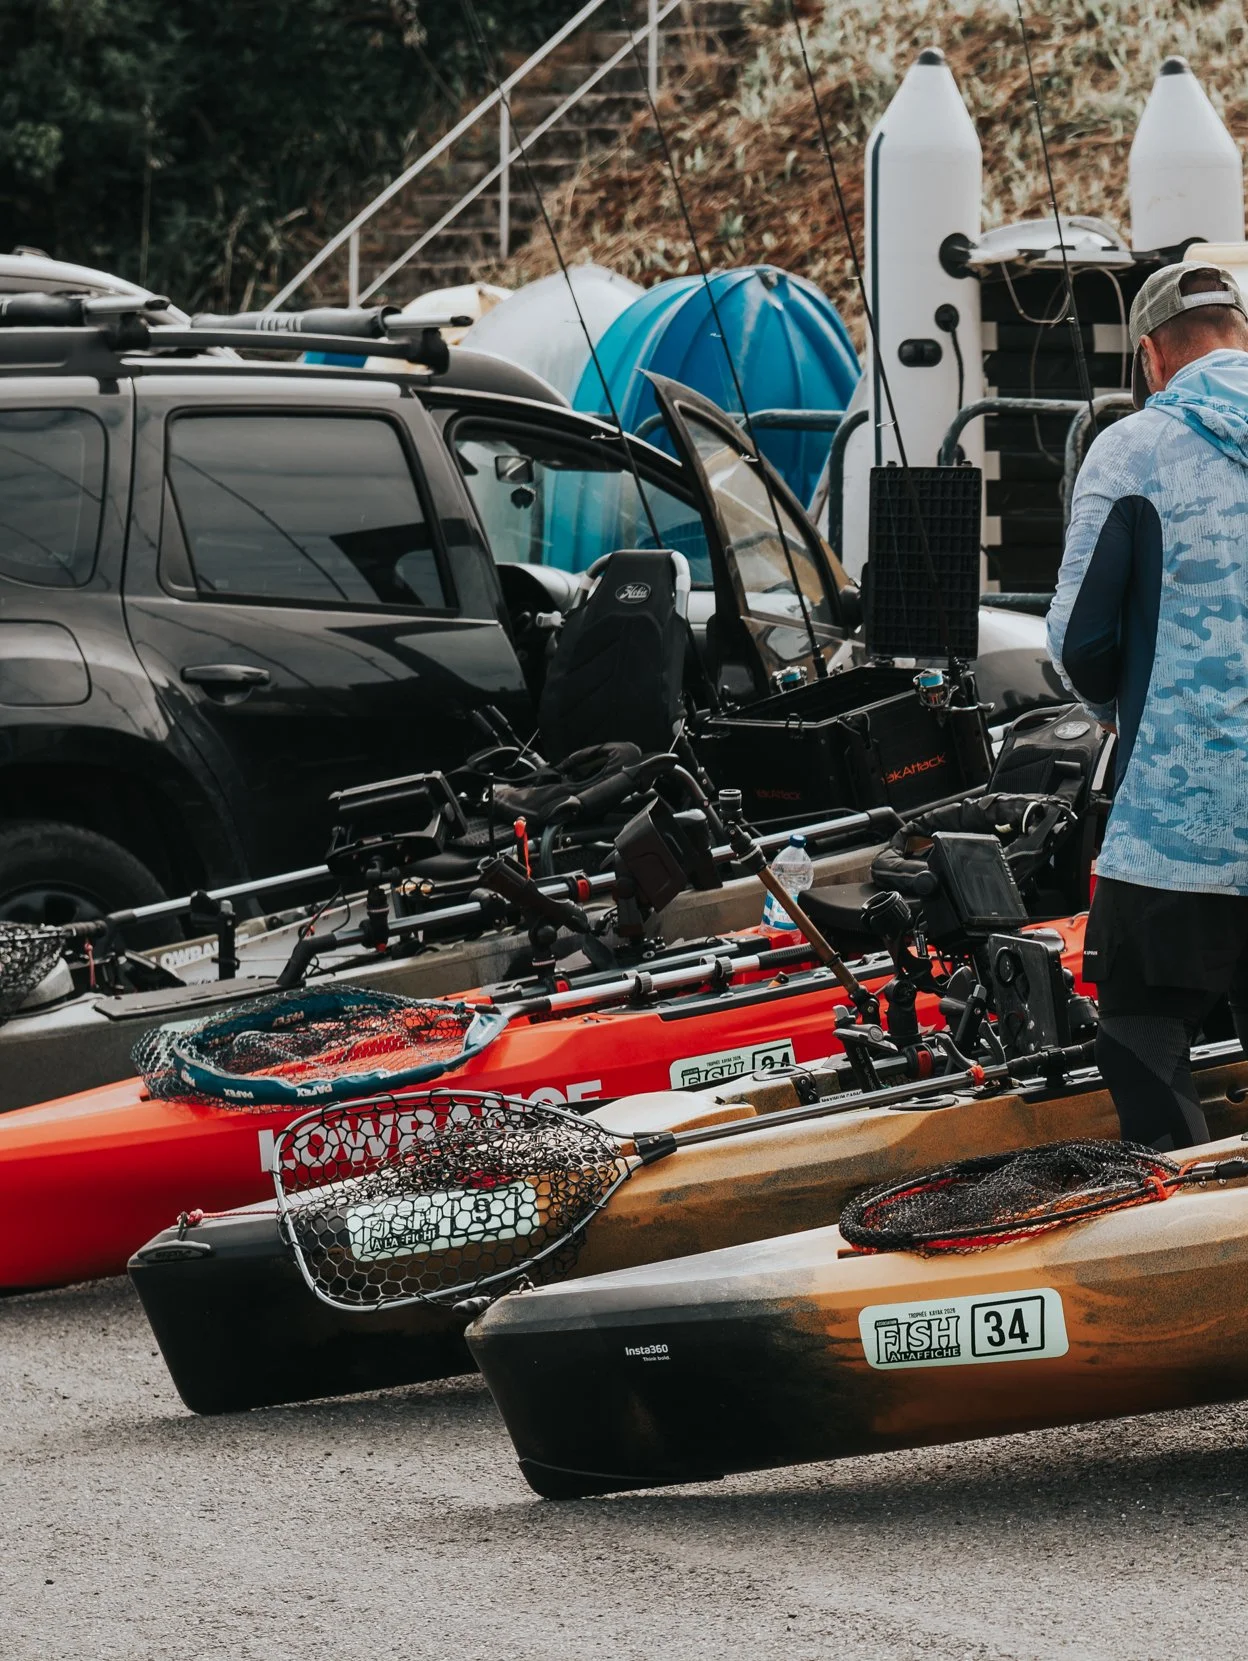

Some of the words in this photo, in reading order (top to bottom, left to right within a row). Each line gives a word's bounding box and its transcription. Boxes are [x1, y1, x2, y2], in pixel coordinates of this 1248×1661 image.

[258, 1079, 602, 1173] LOWRA
[875, 1316, 961, 1364] FISH
[984, 1308, 1030, 1347] 34
[625, 1344, 669, 1356] Insta360
[901, 1347, 960, 1361] L'AFFICHE
